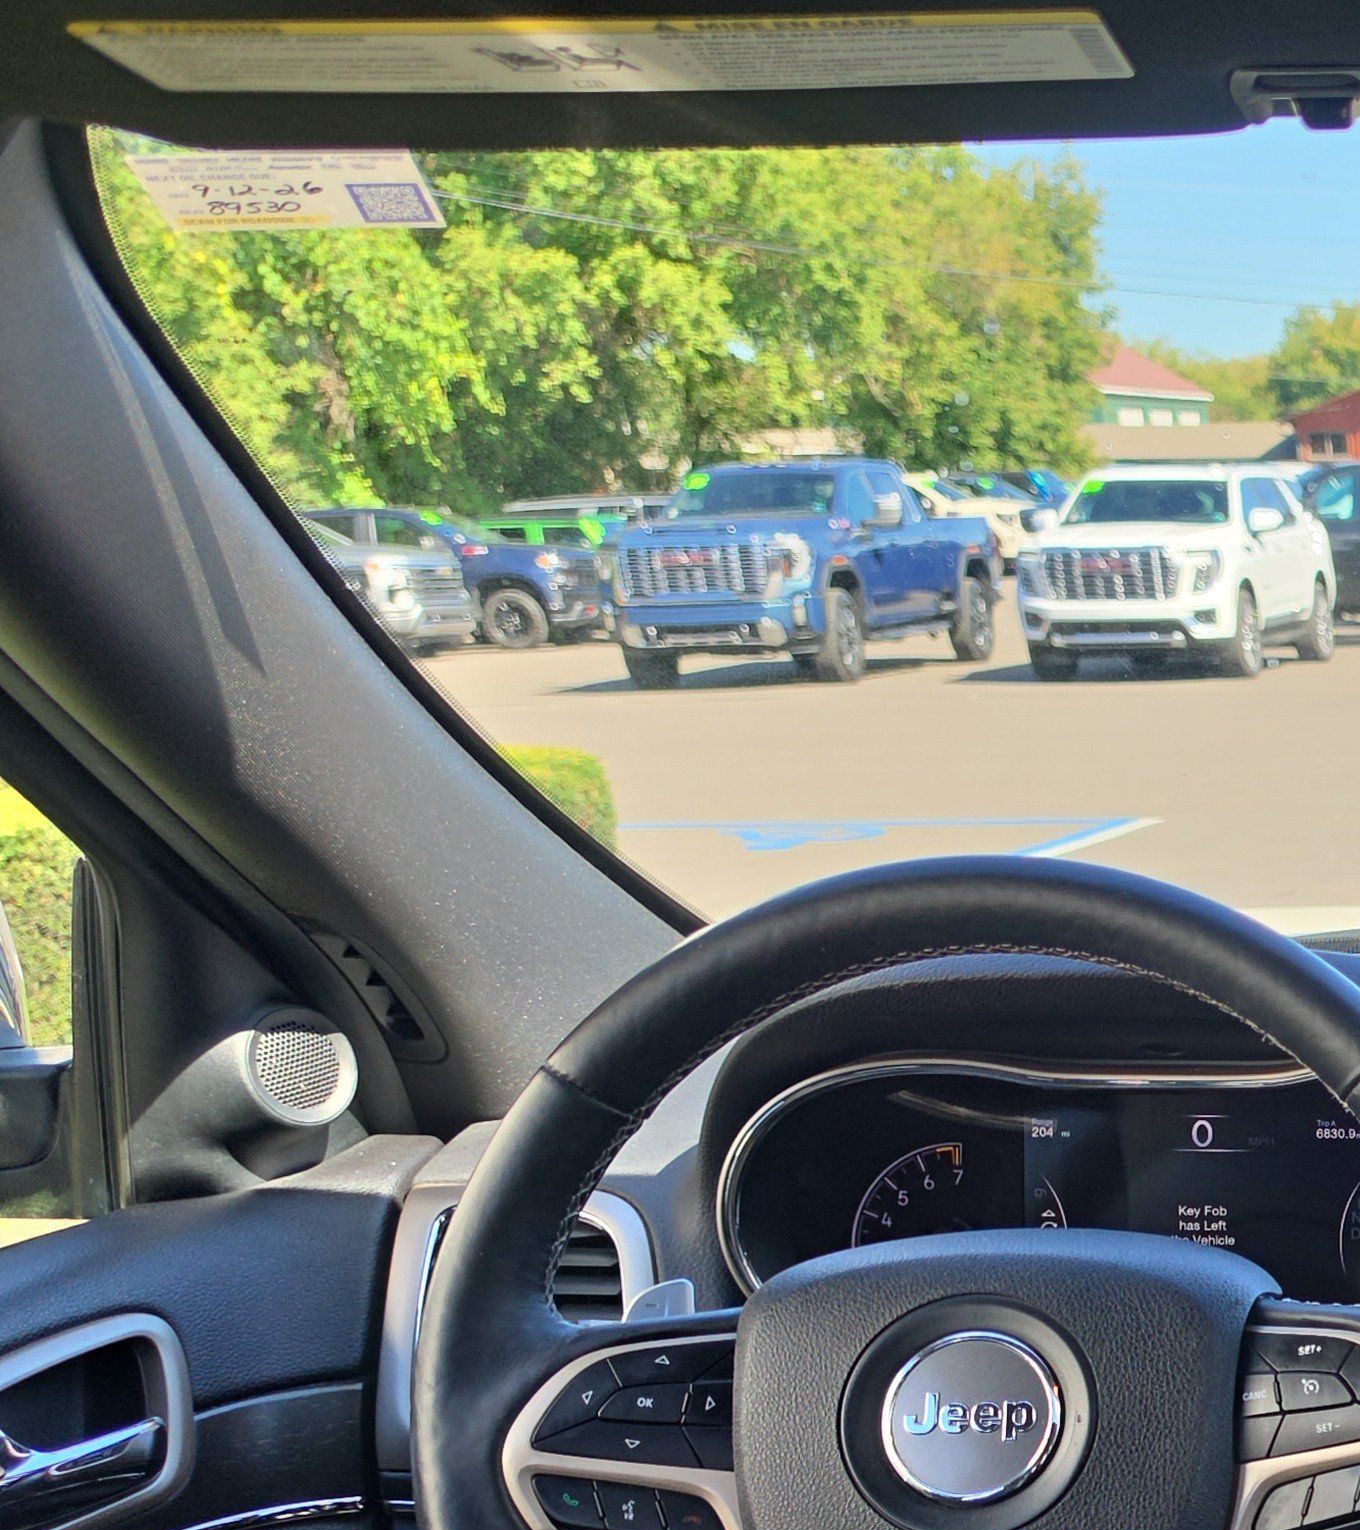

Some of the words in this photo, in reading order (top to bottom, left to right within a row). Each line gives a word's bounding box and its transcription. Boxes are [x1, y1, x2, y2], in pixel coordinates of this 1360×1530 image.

[207, 200, 301, 216] 89530
[1031, 1126, 1054, 1138] 204
[1061, 1129, 1071, 1138] mi
[1190, 1119, 1214, 1148] 0
[923, 1174, 936, 1191] 6
[953, 1169, 964, 1186] 7
[897, 1190, 909, 1206] 5
[880, 1211, 893, 1228] 4
[1178, 1205, 1201, 1219] Key
[1204, 1205, 1228, 1217] Fob
[1178, 1220, 1201, 1232] has
[1203, 1220, 1227, 1232] Left
[1193, 1234, 1236, 1246] Vehicle
[636, 1397, 654, 1409] OK
[903, 1391, 1037, 1442] Jeep
